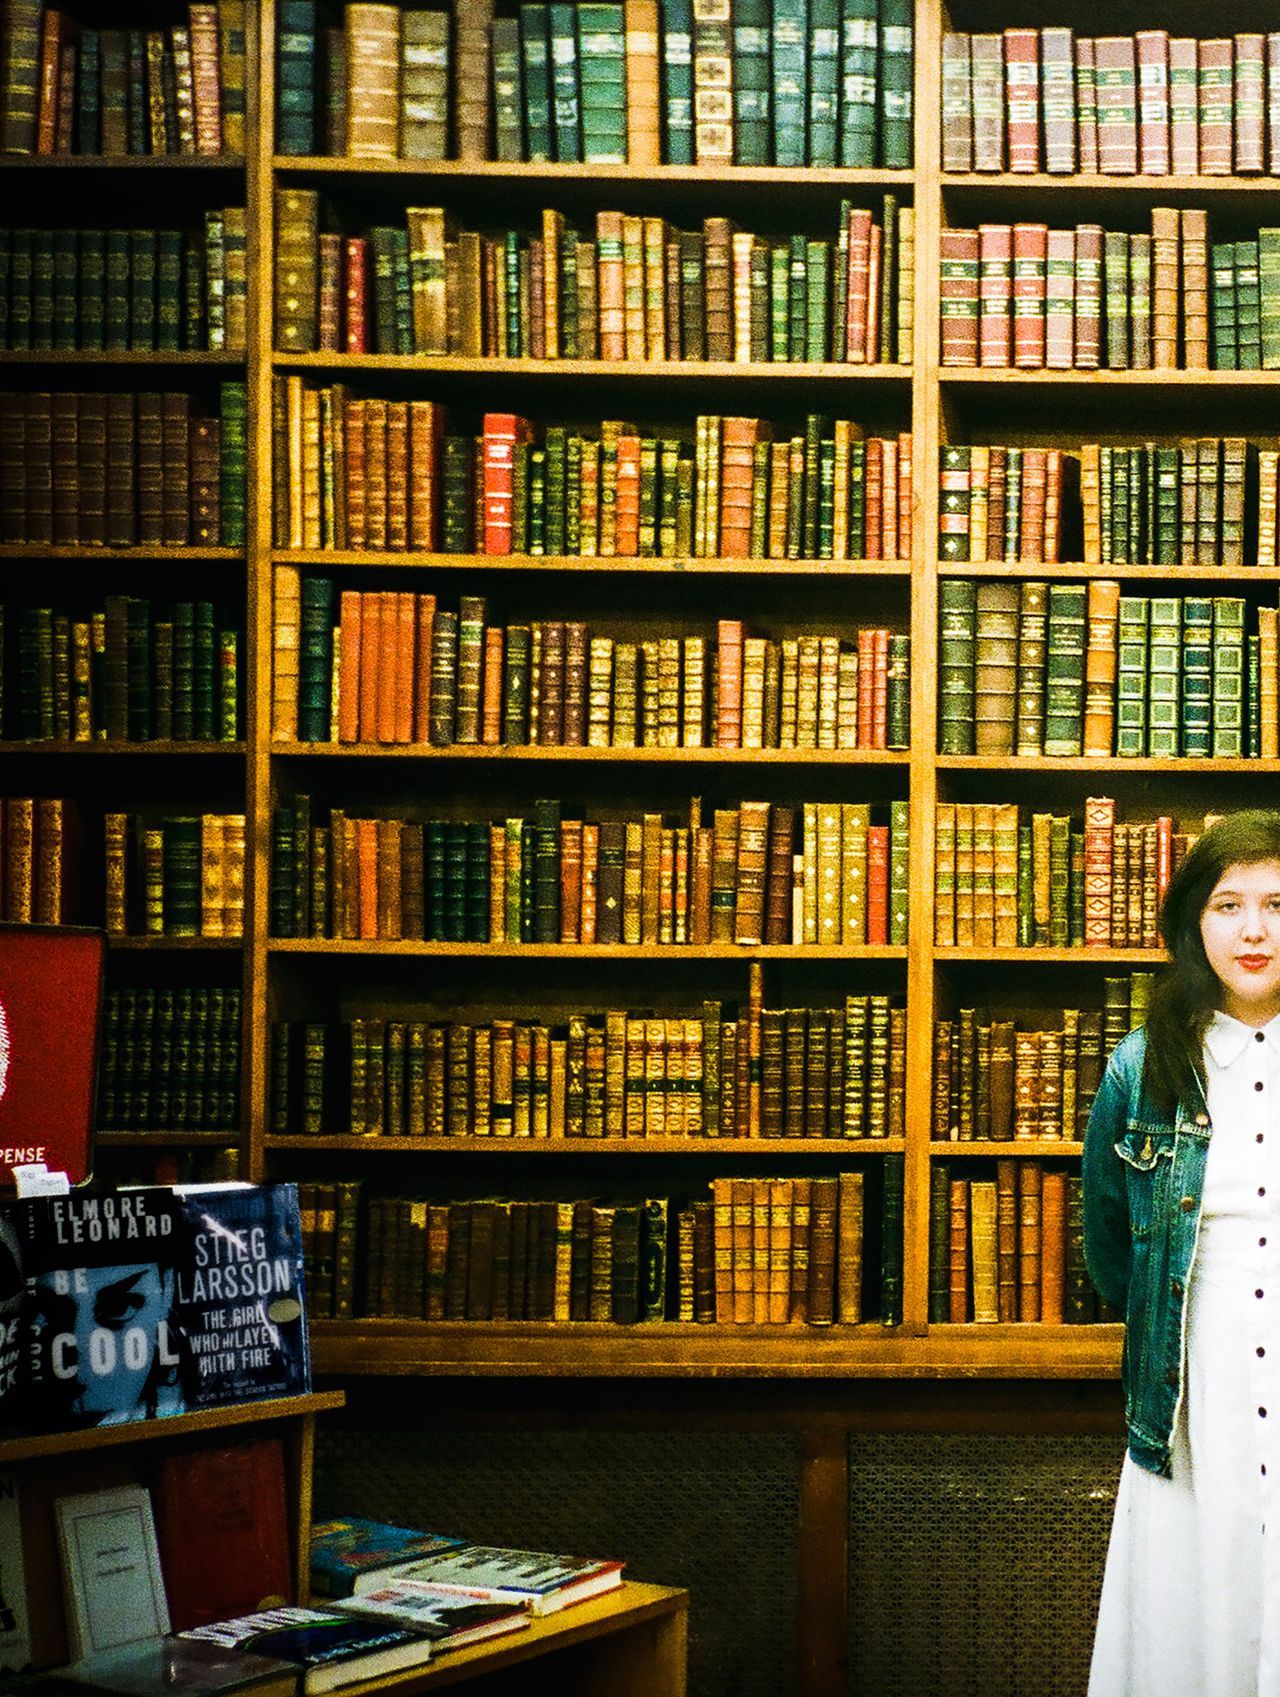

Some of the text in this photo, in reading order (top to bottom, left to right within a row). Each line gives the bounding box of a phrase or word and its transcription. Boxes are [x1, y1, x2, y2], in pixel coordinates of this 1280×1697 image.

[53, 1196, 146, 1222] ELMORE
[56, 1213, 172, 1244] LEONARD
[195, 1227, 267, 1267] STIEG
[54, 1267, 88, 1295] BE
[177, 1259, 290, 1304] LARSSON
[201, 1302, 264, 1330] THE GIRL
[52, 1320, 181, 1380] COOL
[190, 1332, 220, 1354] WHO
[199, 1347, 271, 1374] WITH FIRE
